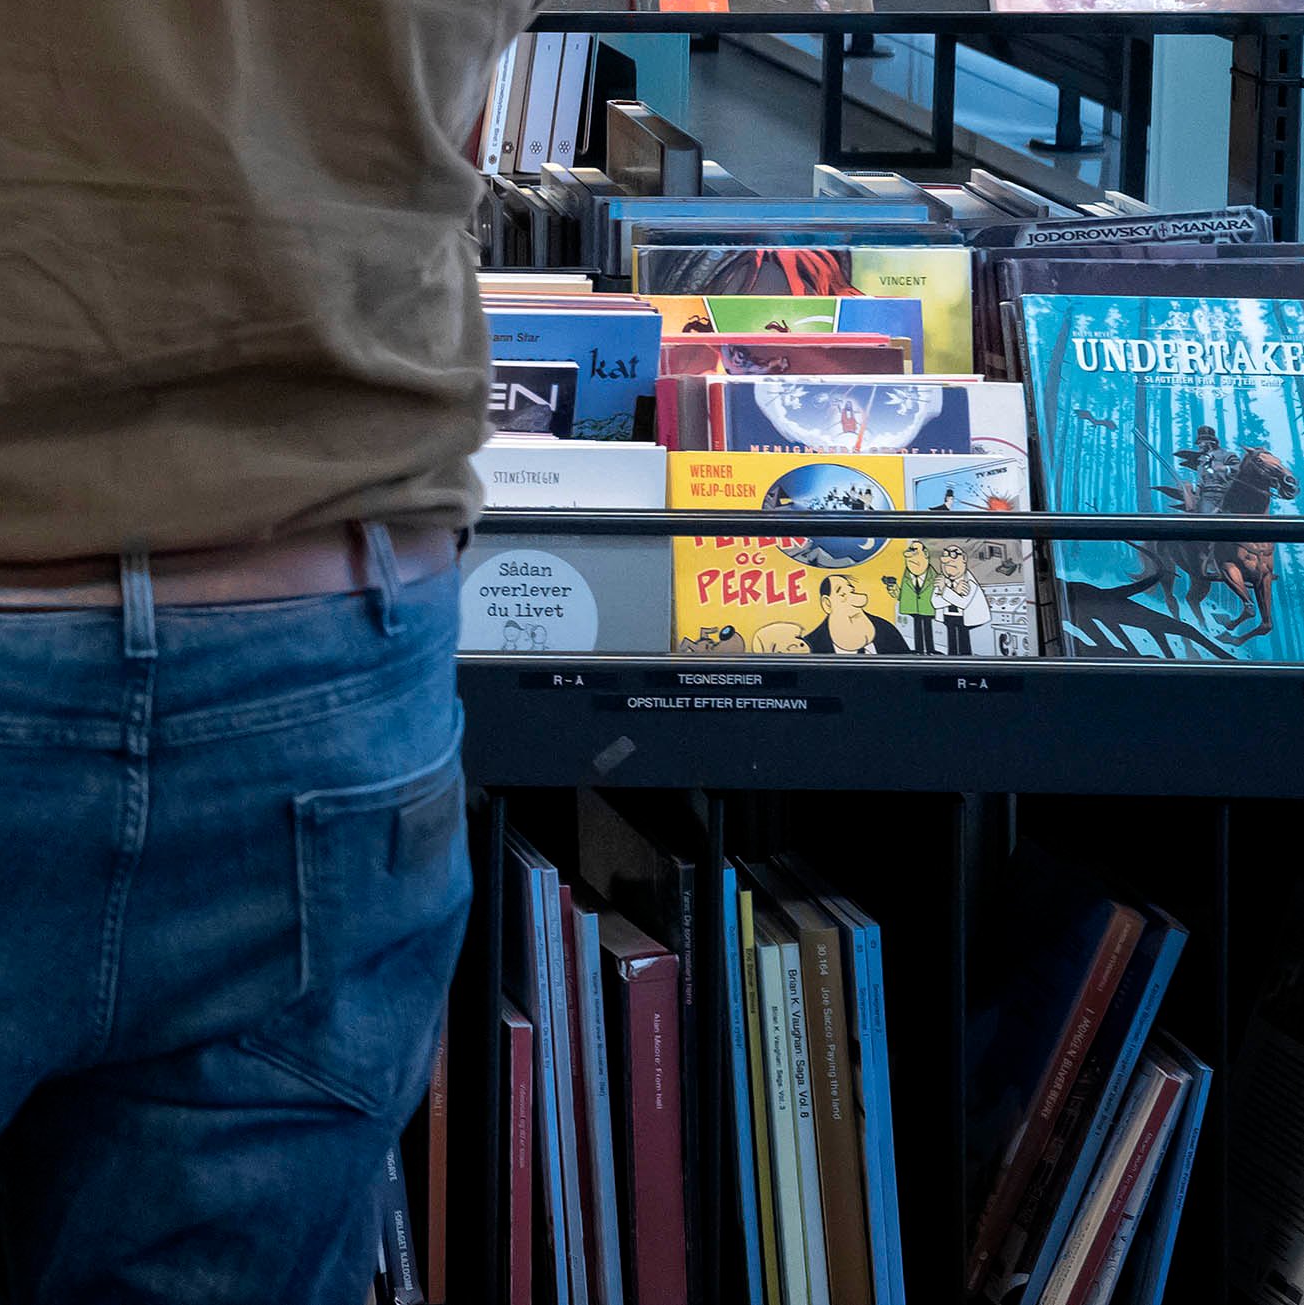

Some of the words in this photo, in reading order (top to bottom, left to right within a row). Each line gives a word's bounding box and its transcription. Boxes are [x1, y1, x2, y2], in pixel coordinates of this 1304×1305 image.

[1026, 225, 1154, 246] JODOROWSKY
[1171, 216, 1255, 234] MANARA
[880, 276, 926, 286] VINCENT
[690, 463, 733, 481] WERNER
[690, 481, 757, 499] WEJP-OLSEN
[735, 552, 765, 565] OG
[499, 562, 552, 577] Sådan
[479, 583, 572, 598] overlever
[696, 569, 808, 606] PERLE
[487, 603, 509, 617] du
[516, 604, 564, 618] livet
[676, 673, 763, 685] TEGNESERIER
[627, 697, 691, 708] OPSTILLET
[693, 697, 733, 708] EFTER
[735, 698, 808, 710] EFTERNAVN
